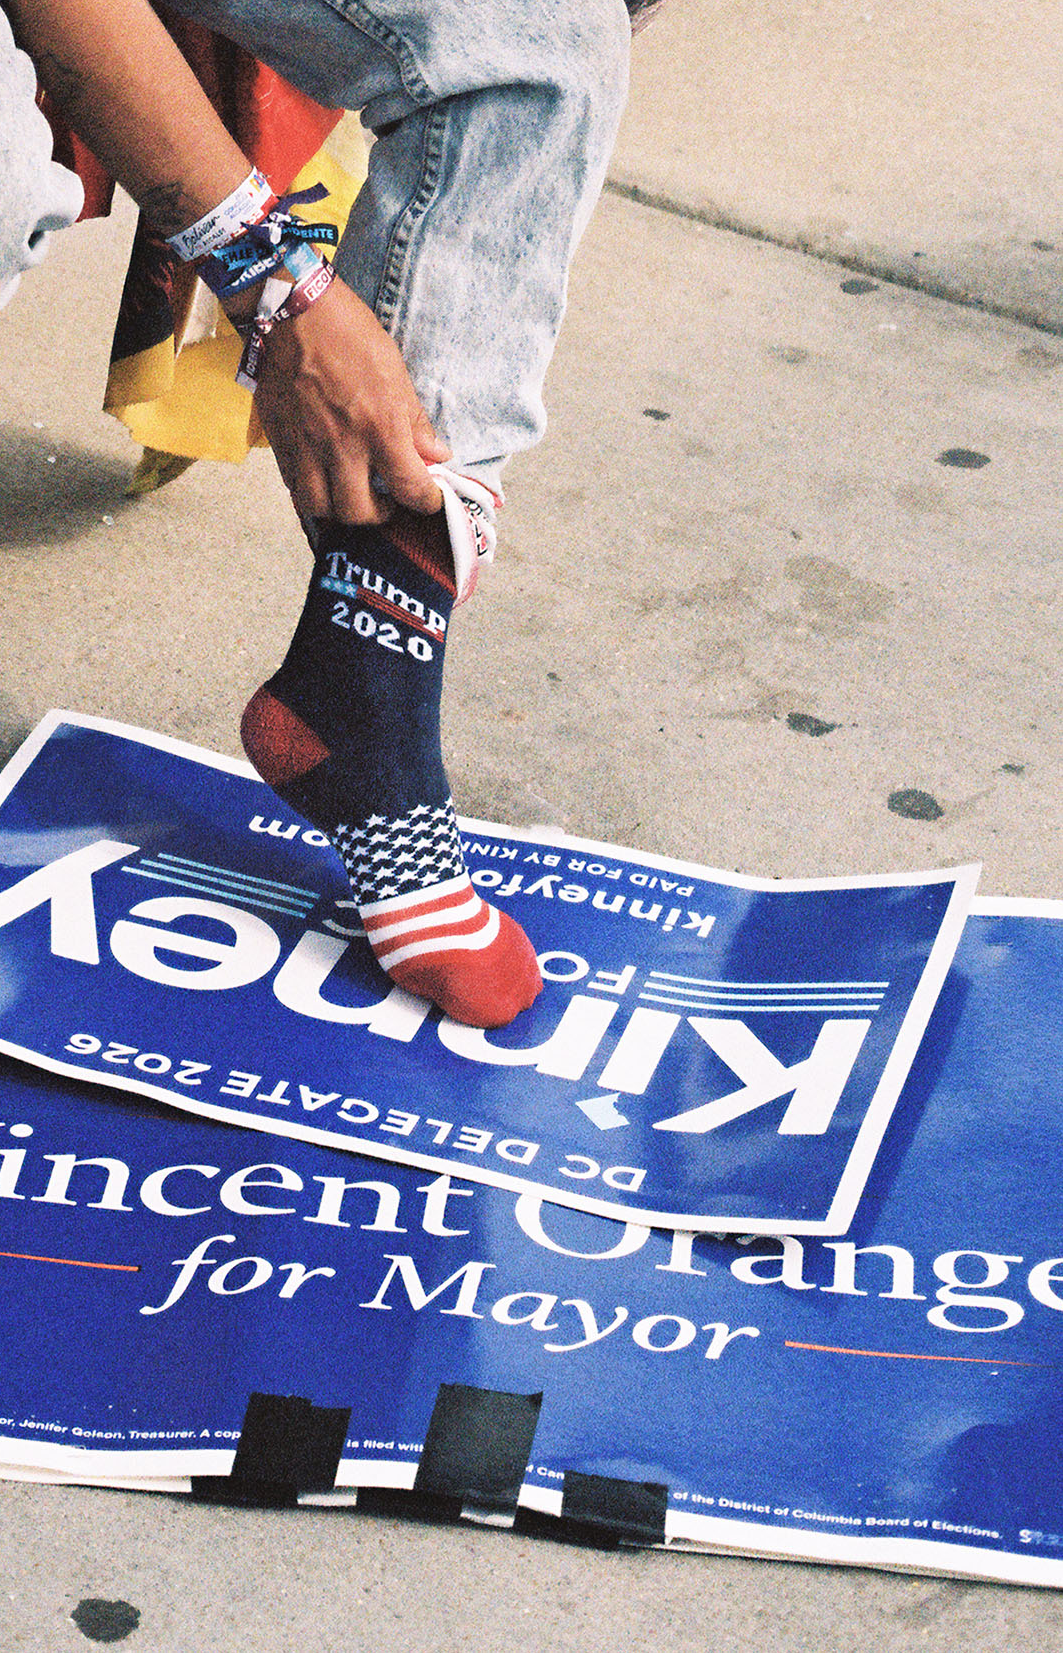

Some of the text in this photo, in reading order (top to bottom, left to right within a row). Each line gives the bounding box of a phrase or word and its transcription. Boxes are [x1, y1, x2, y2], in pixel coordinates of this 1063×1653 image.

[305, 269, 331, 300] FICO
[325, 551, 447, 635] Trump
[330, 601, 433, 662] 2020
[523, 851, 563, 867] BY
[568, 857, 624, 880] FOR
[629, 873, 695, 897] PAID
[537, 950, 637, 995] FO
[63, 1032, 648, 1192] DC DELEGATE 2026
[139, 1234, 761, 1361] for Mayor
[19, 1419, 68, 1434] Jenifer
[199, 1428, 211, 1439] A
[214, 1429, 242, 1441] cop
[347, 1438, 360, 1449] is
[363, 1438, 394, 1451] filed
[673, 1491, 688, 1502] of
[691, 1493, 715, 1506] the
[718, 1496, 771, 1515] District
[773, 1506, 789, 1517] of
[792, 1509, 863, 1528] Columbia
[865, 1515, 910, 1529] Board
[913, 1515, 930, 1530] of
